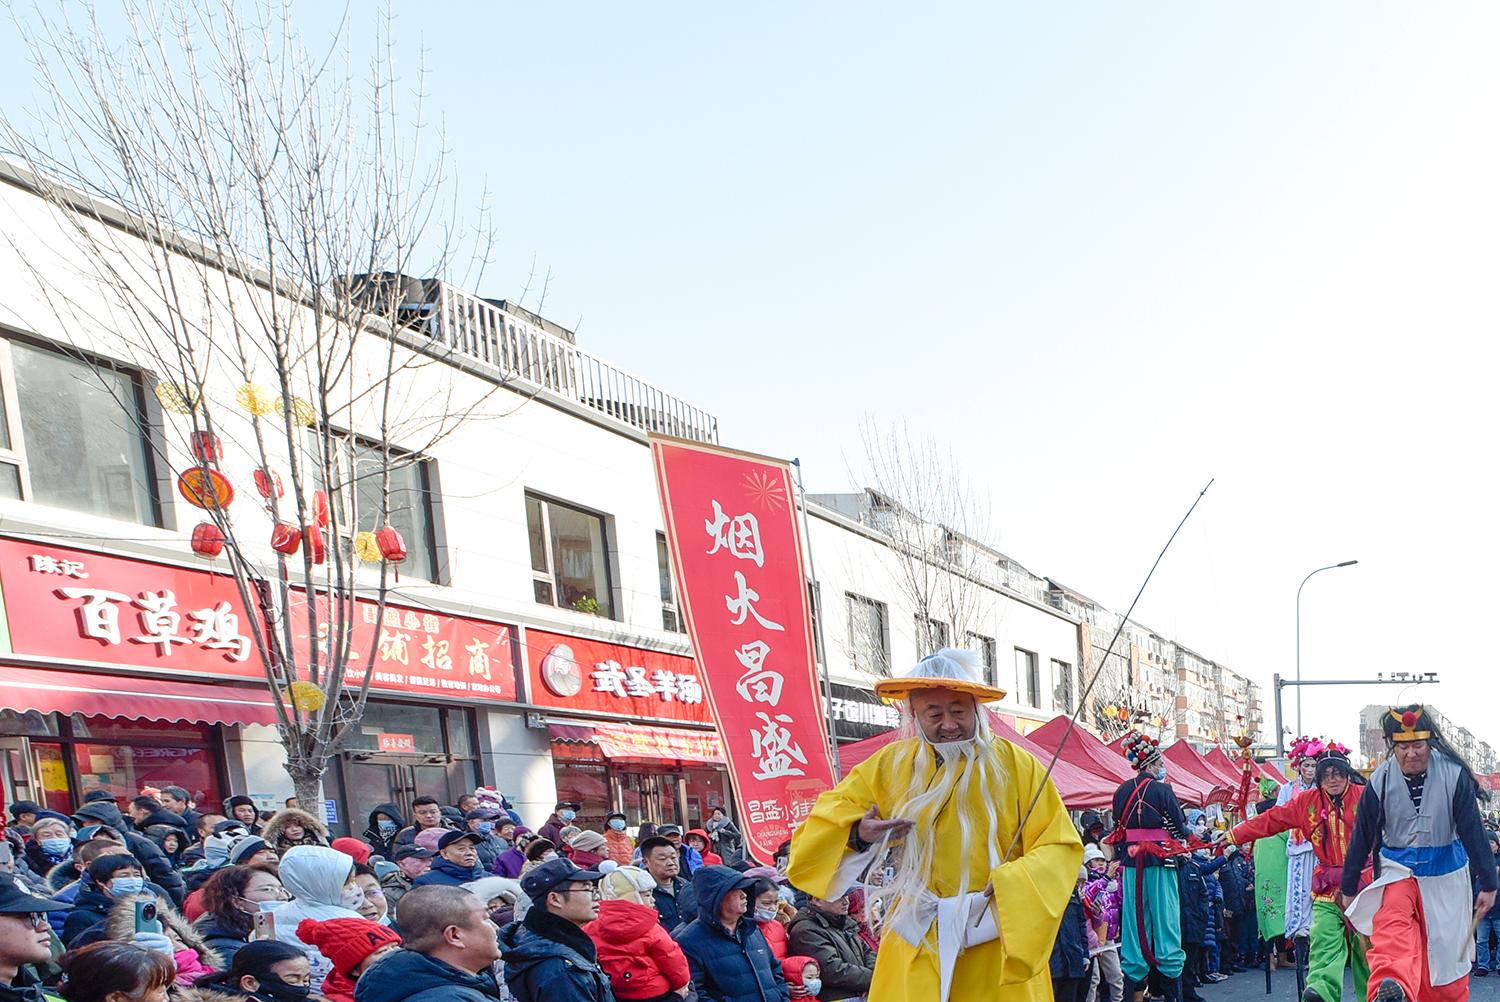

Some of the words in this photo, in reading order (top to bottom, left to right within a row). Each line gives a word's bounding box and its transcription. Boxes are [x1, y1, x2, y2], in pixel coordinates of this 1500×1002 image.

[31, 553, 90, 580] 陈记
[56, 587, 252, 664] 百草鸡
[704, 499, 808, 783] 烟火昌盛
[591, 659, 703, 705] 武圣羊汤
